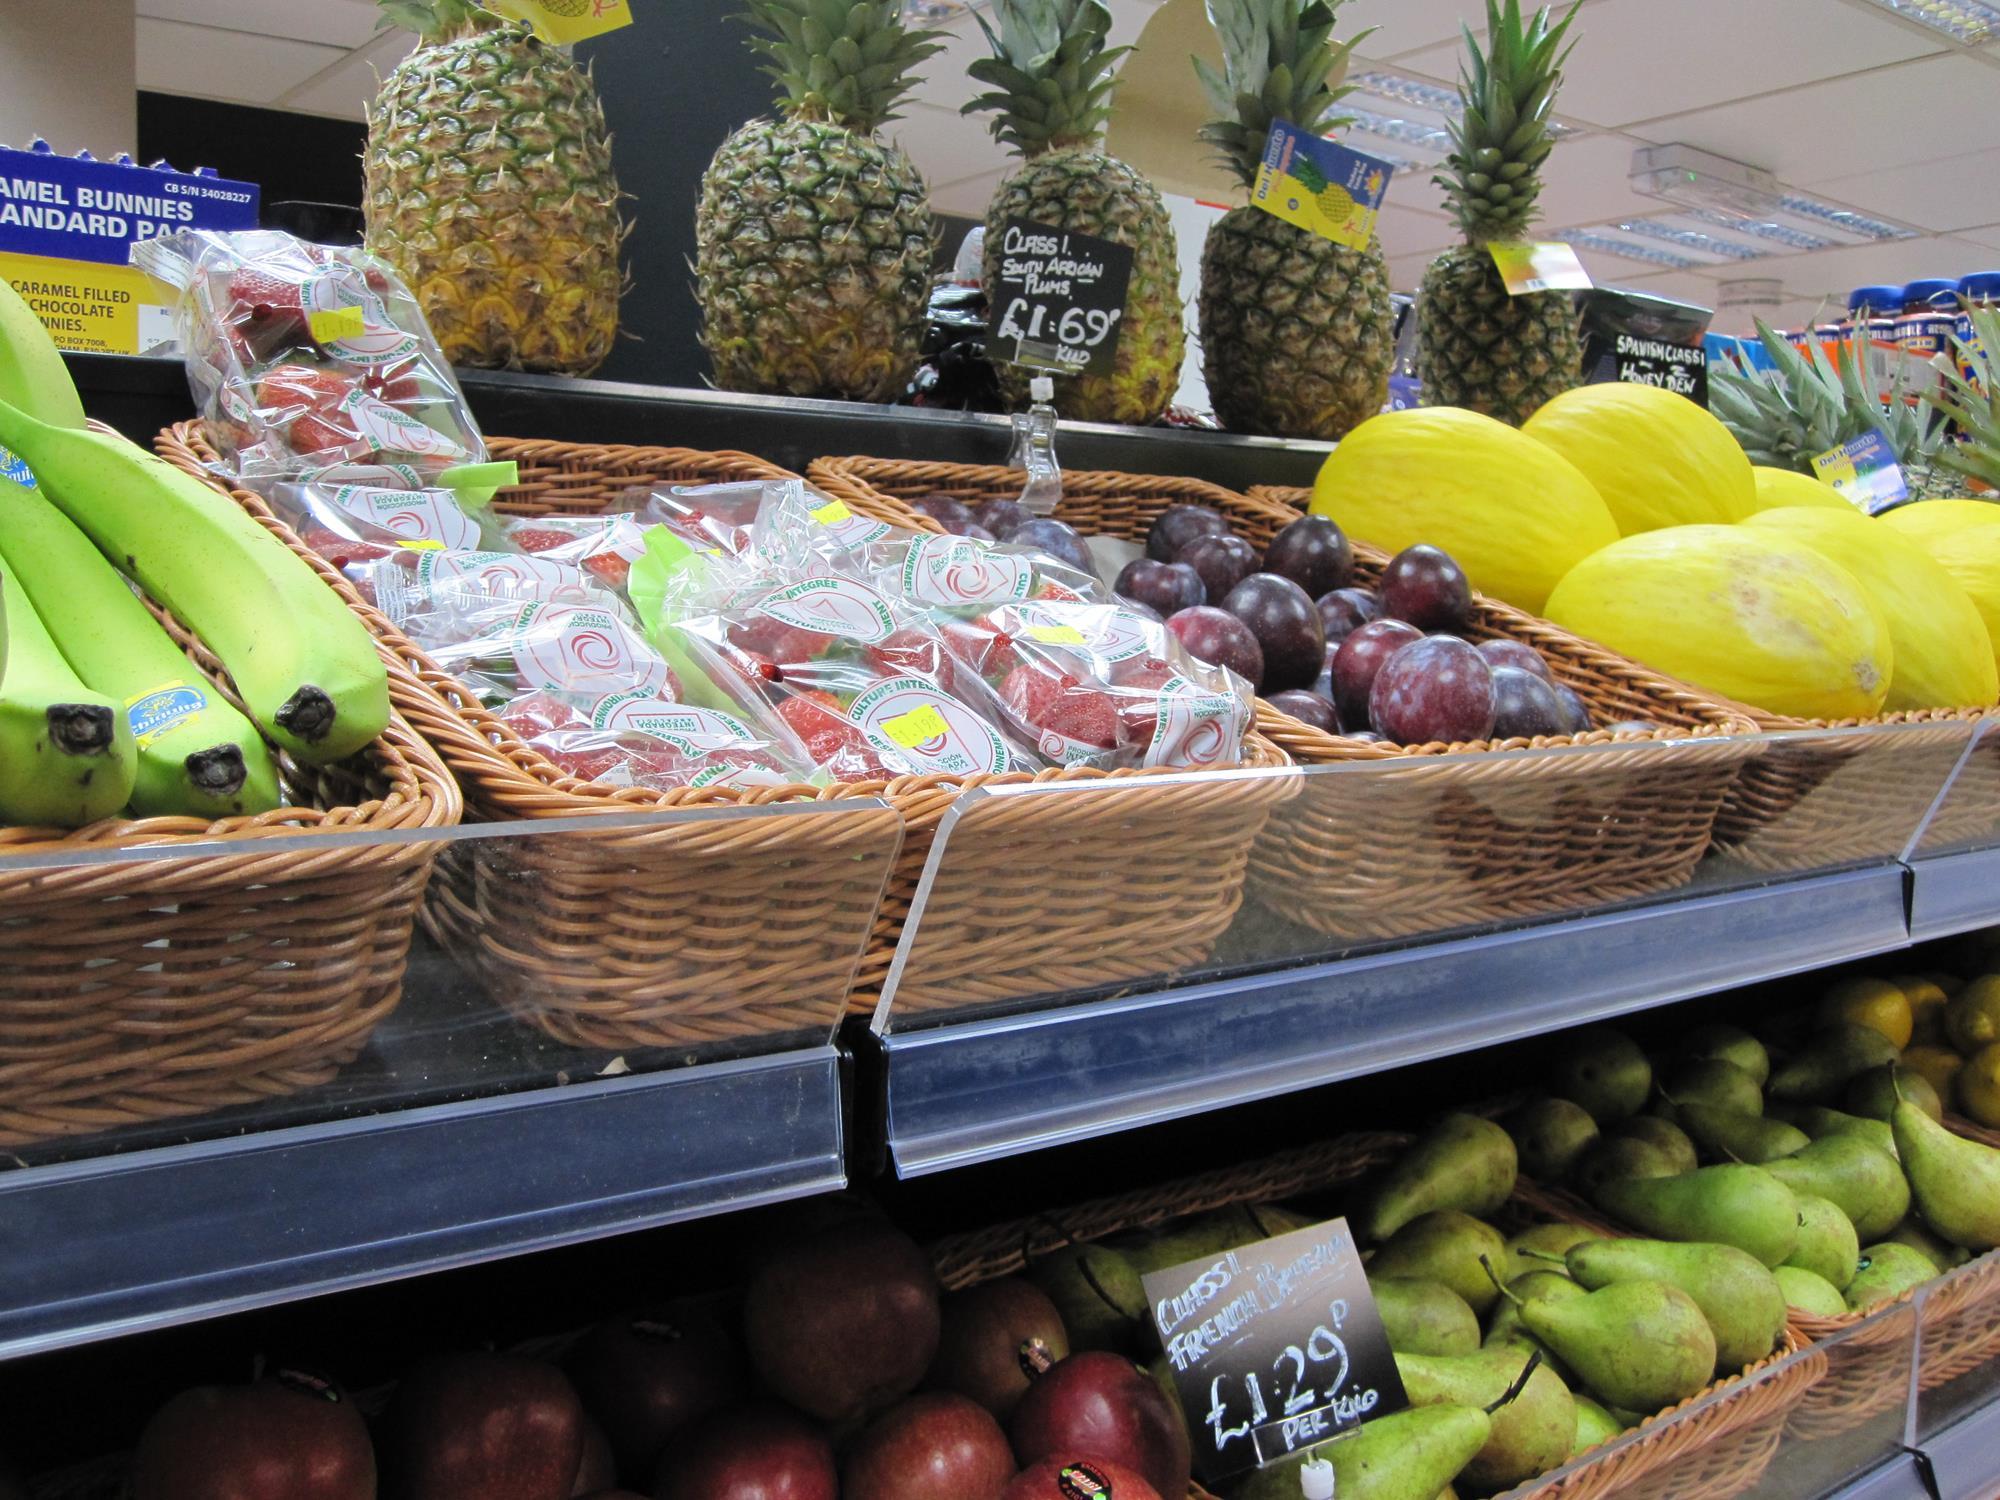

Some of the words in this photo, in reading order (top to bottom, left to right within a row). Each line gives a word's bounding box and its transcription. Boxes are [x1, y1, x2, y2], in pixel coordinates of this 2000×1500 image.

[77, 187, 193, 221] BUNNIES
[164, 183, 179, 194] CB
[181, 185, 199, 196] S/N
[201, 188, 251, 203] 34028227
[0, 203, 128, 238] ANDARD
[1004, 226, 1059, 255] CLASS
[1001, 258, 1044, 275] SOUTH
[1045, 255, 1103, 278] AFRICAN
[11, 280, 79, 299] CARAMEL
[84, 287, 131, 304] FILLED
[30, 299, 115, 318] CHOCOLATE
[37, 315, 87, 332] NNIES.
[1665, 345, 1700, 365] CLASS
[1621, 361, 1664, 388] HONEY
[1665, 374, 1696, 394] DEW
[1157, 1260, 1232, 1335] CLASS
[1168, 1290, 1264, 1371] FRENCH
[1282, 1410, 1329, 1450] PER
